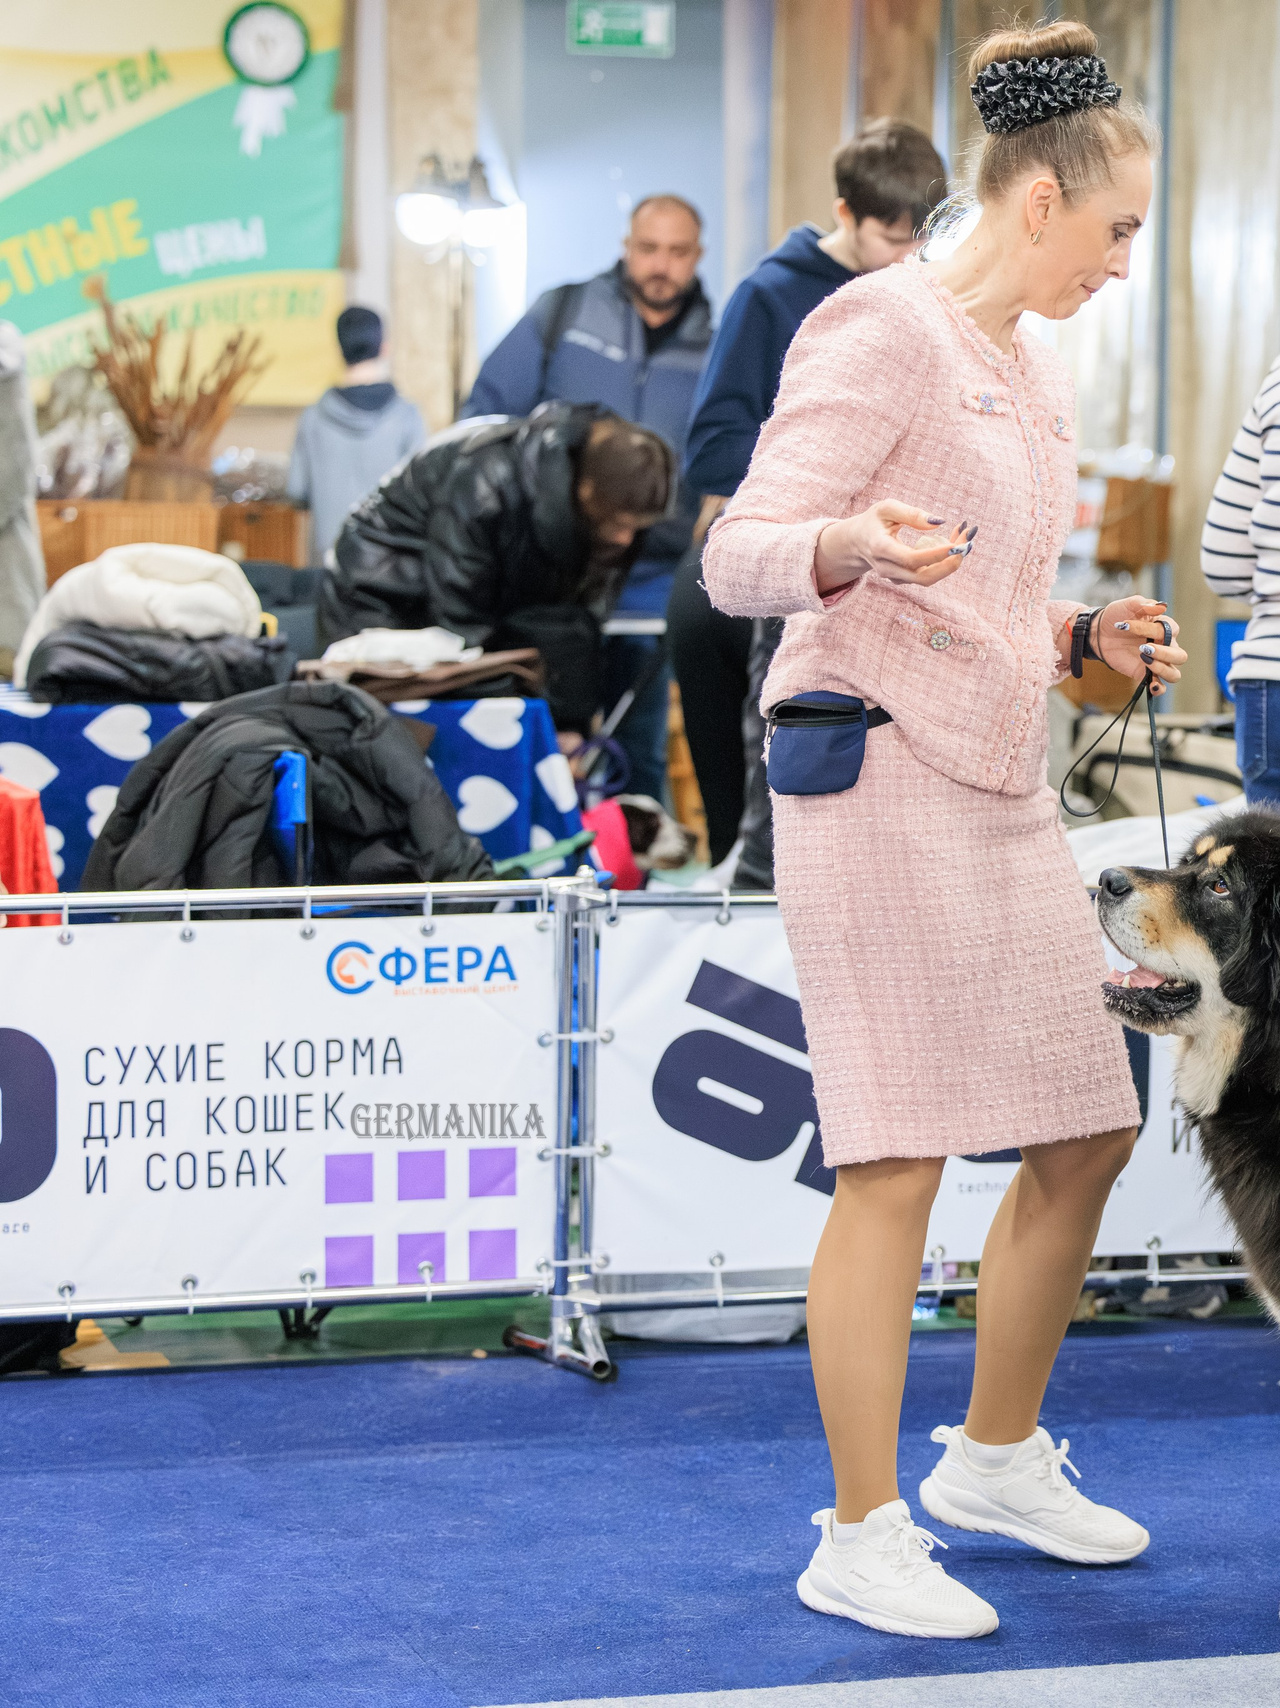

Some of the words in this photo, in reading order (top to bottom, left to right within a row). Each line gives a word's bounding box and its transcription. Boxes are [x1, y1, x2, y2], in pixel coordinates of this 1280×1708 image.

[0, 198, 148, 306] ТНЫЕ
[326, 941, 518, 995] СФЕРА
[84, 1044, 225, 1086] СУХИЕ
[265, 1037, 403, 1079] КОРМА
[83, 1100, 166, 1149] ДЛЯ
[206, 1091, 345, 1135] КОШЕК
[86, 1156, 107, 1194] И
[146, 1148, 287, 1191] СОБАК
[957, 1179, 1007, 1194] techno
